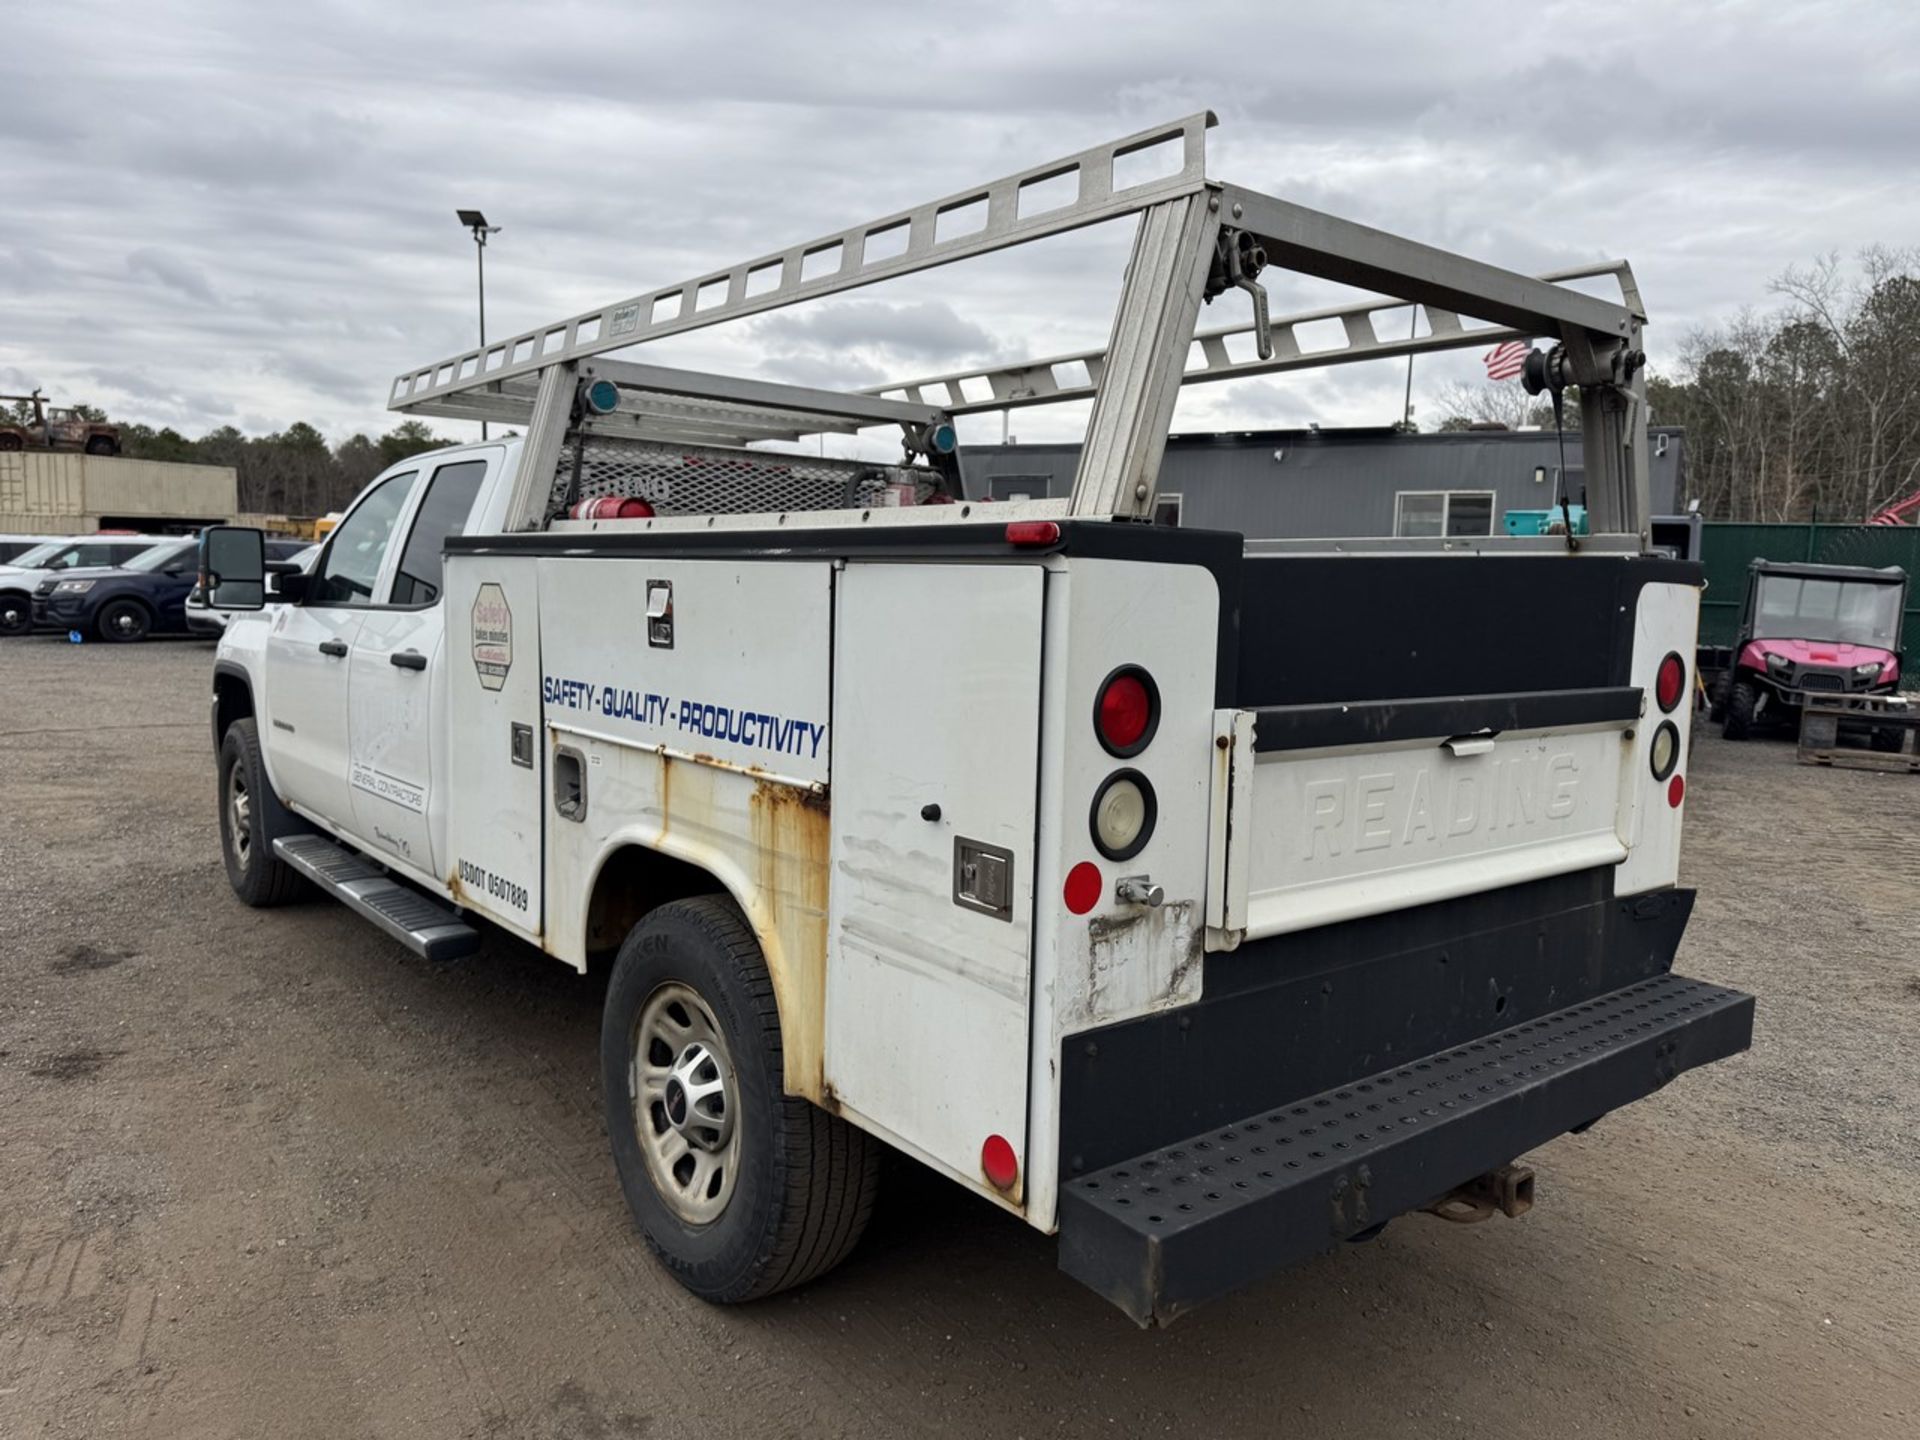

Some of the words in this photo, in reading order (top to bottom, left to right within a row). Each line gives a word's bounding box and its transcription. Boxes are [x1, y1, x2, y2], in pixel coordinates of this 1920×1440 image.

[545, 676, 595, 711] SAFETY
[602, 687, 669, 726] QUALITY
[678, 700, 825, 758] PRODUCTIVITY
[1303, 753, 1580, 861] READING
[458, 858, 486, 890] USDOT
